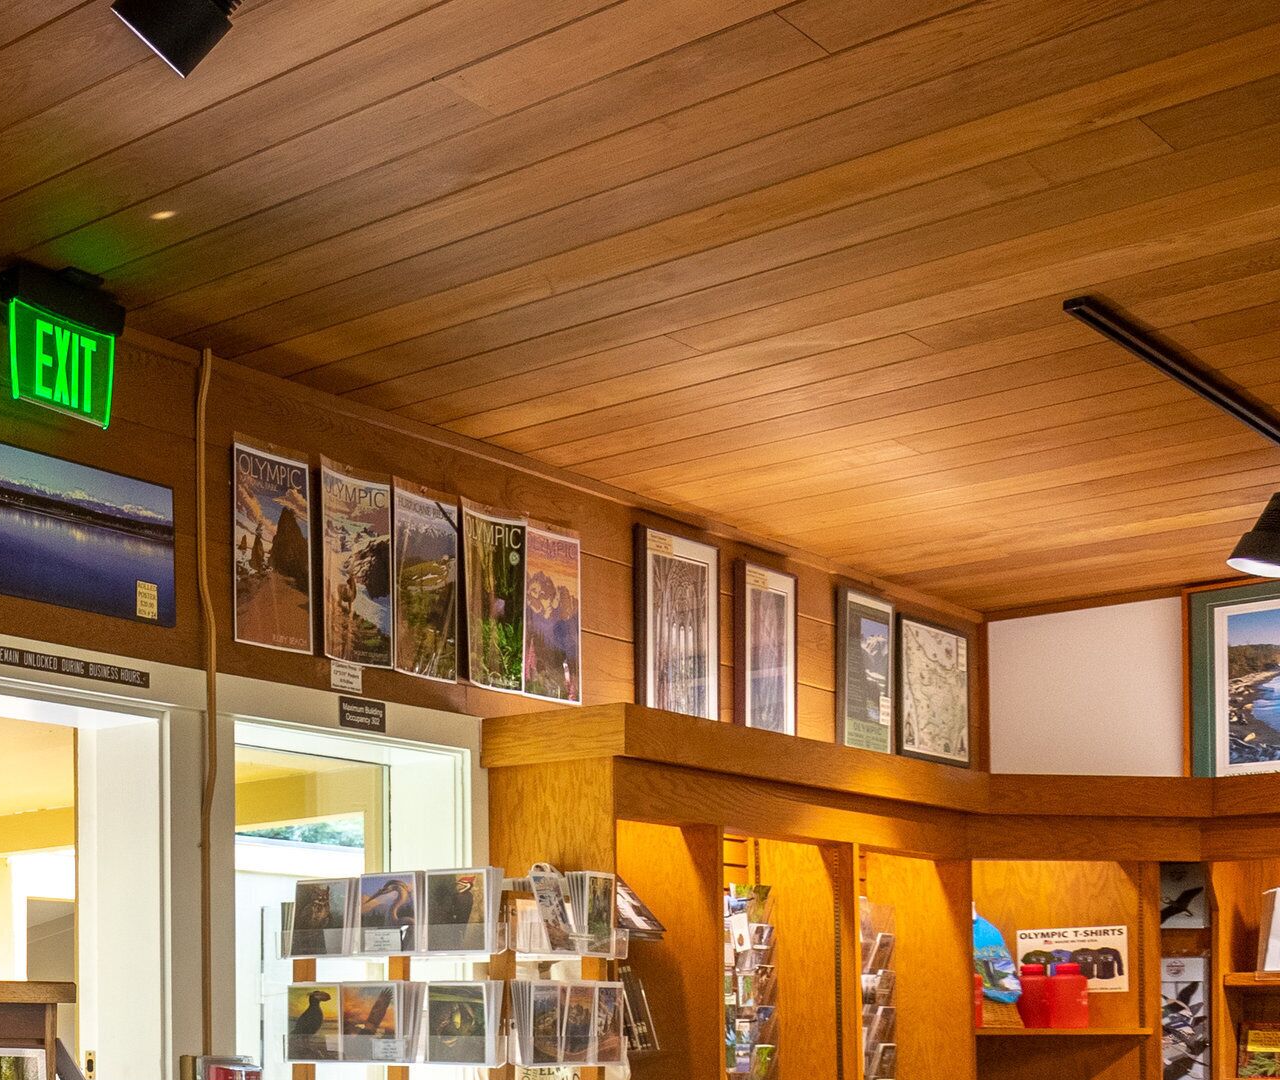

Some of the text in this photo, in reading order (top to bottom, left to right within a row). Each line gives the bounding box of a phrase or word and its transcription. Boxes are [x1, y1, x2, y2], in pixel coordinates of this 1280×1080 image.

[35, 318, 96, 413] EXIT
[239, 454, 302, 490] OLYMPIC
[465, 513, 522, 549] OLYMPIC
[24, 653, 57, 670] UNLOCKED
[62, 659, 84, 674] DURING
[90, 664, 118, 679] BUSINESS
[343, 702, 382, 717] Maximum Building
[346, 713, 380, 725] Occupancy 302
[1020, 929, 1124, 940] OLYMPIC T-SHIRTS
